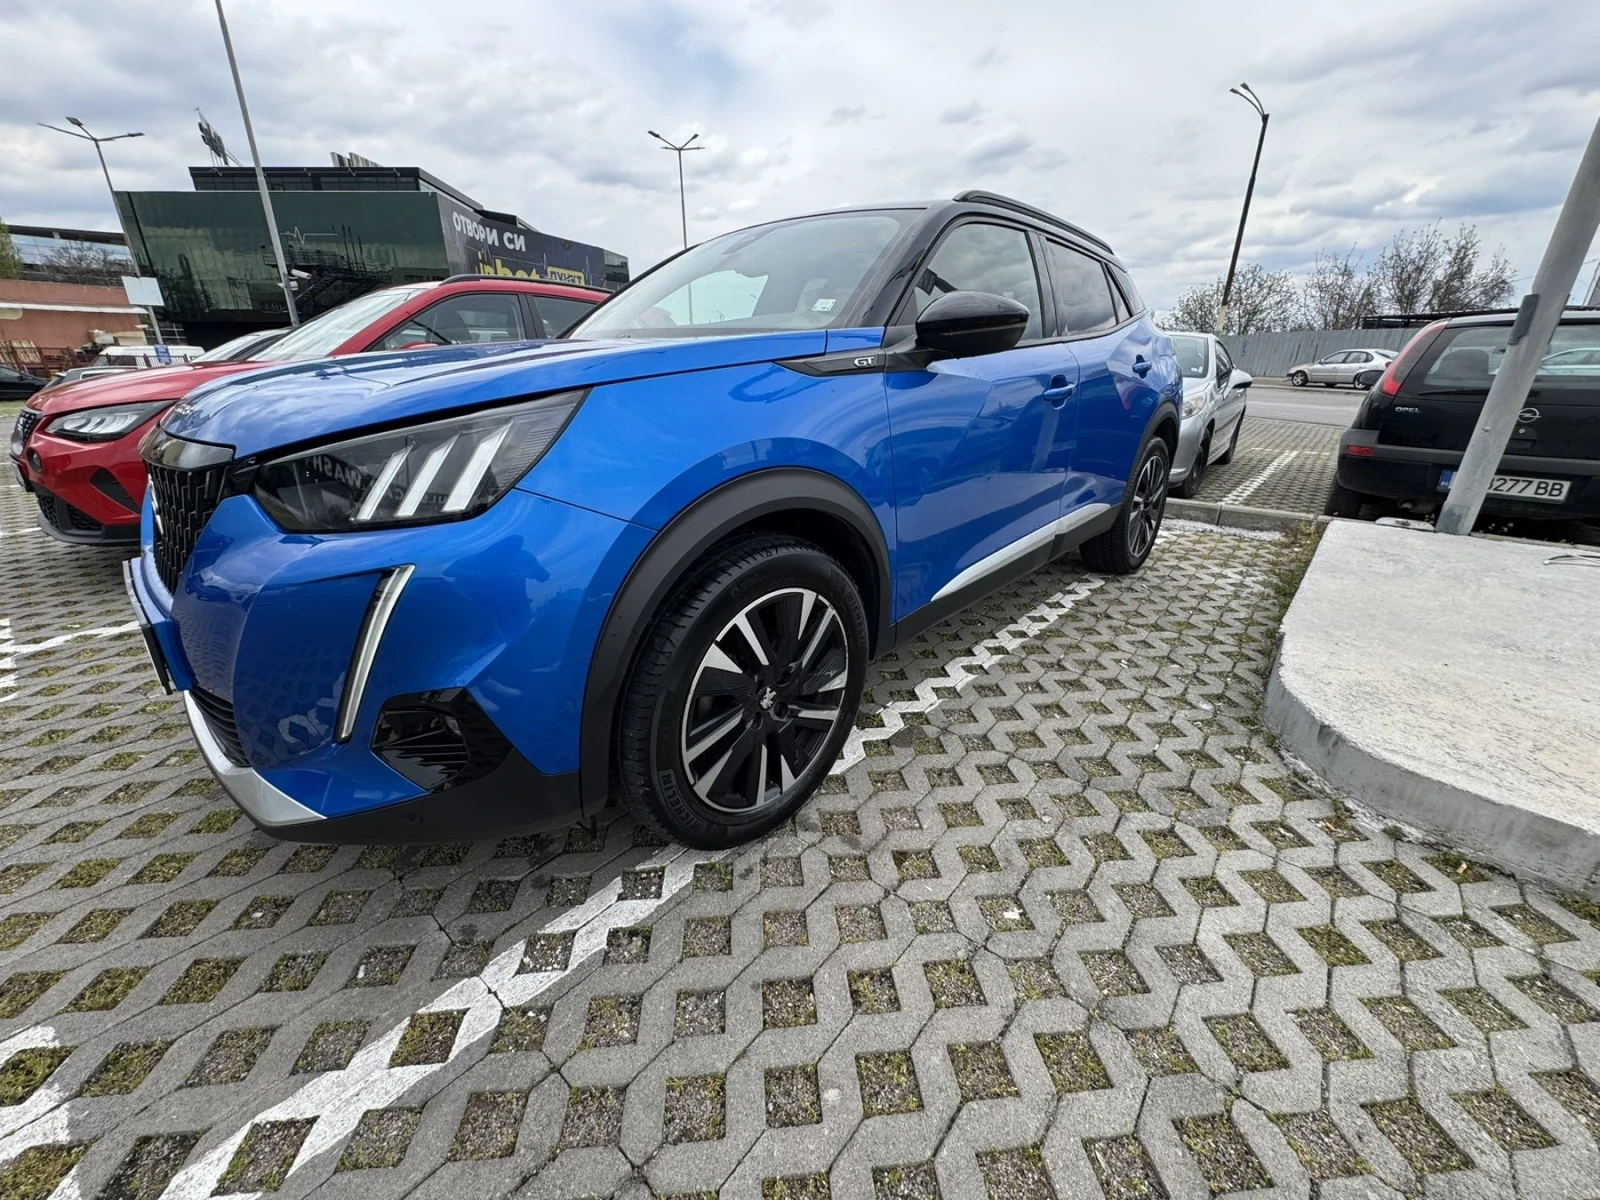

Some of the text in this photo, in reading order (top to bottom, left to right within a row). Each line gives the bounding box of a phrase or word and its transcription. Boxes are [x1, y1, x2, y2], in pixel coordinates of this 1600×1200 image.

[452, 211, 526, 252] ОТВОРИ СИ
[853, 356, 875, 368] GT
[1395, 406, 1421, 414] OPEL
[1488, 477, 1565, 497] 277 BB
[661, 773, 703, 831] MICHELIN
